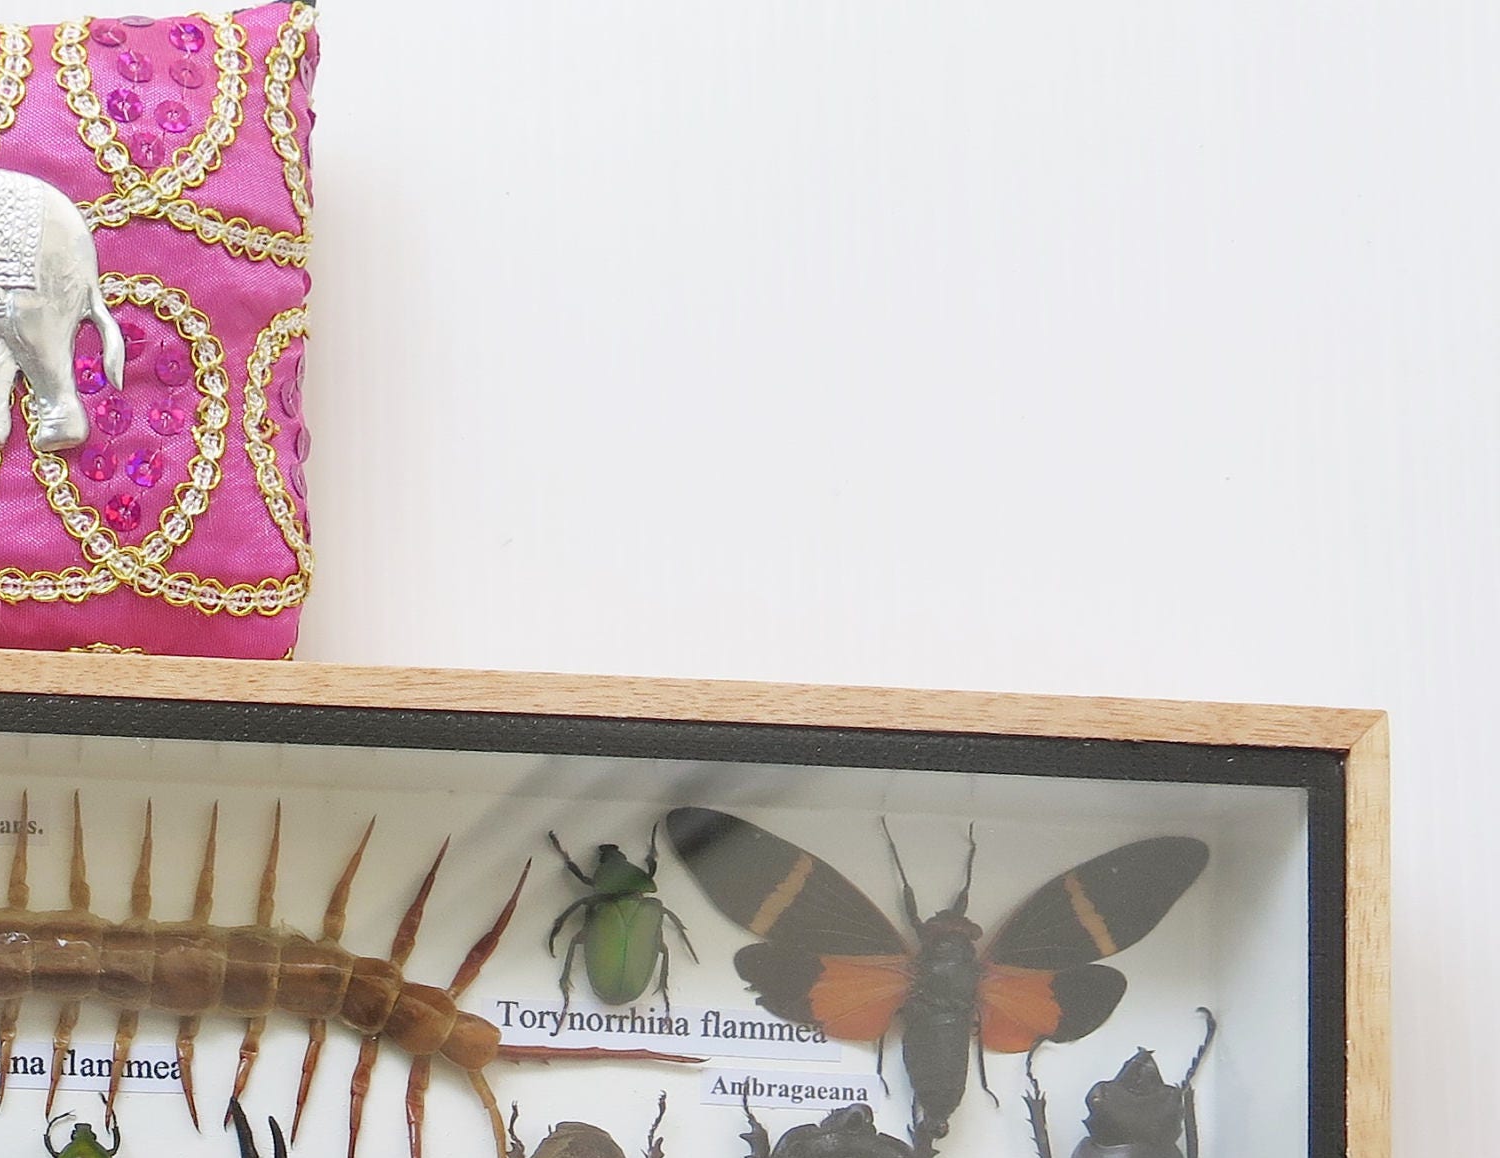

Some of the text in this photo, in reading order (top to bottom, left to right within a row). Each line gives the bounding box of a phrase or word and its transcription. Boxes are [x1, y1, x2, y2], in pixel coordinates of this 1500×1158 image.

[496, 1000, 829, 1043] Torynorrhina flammea
[53, 1047, 182, 1080] lammea
